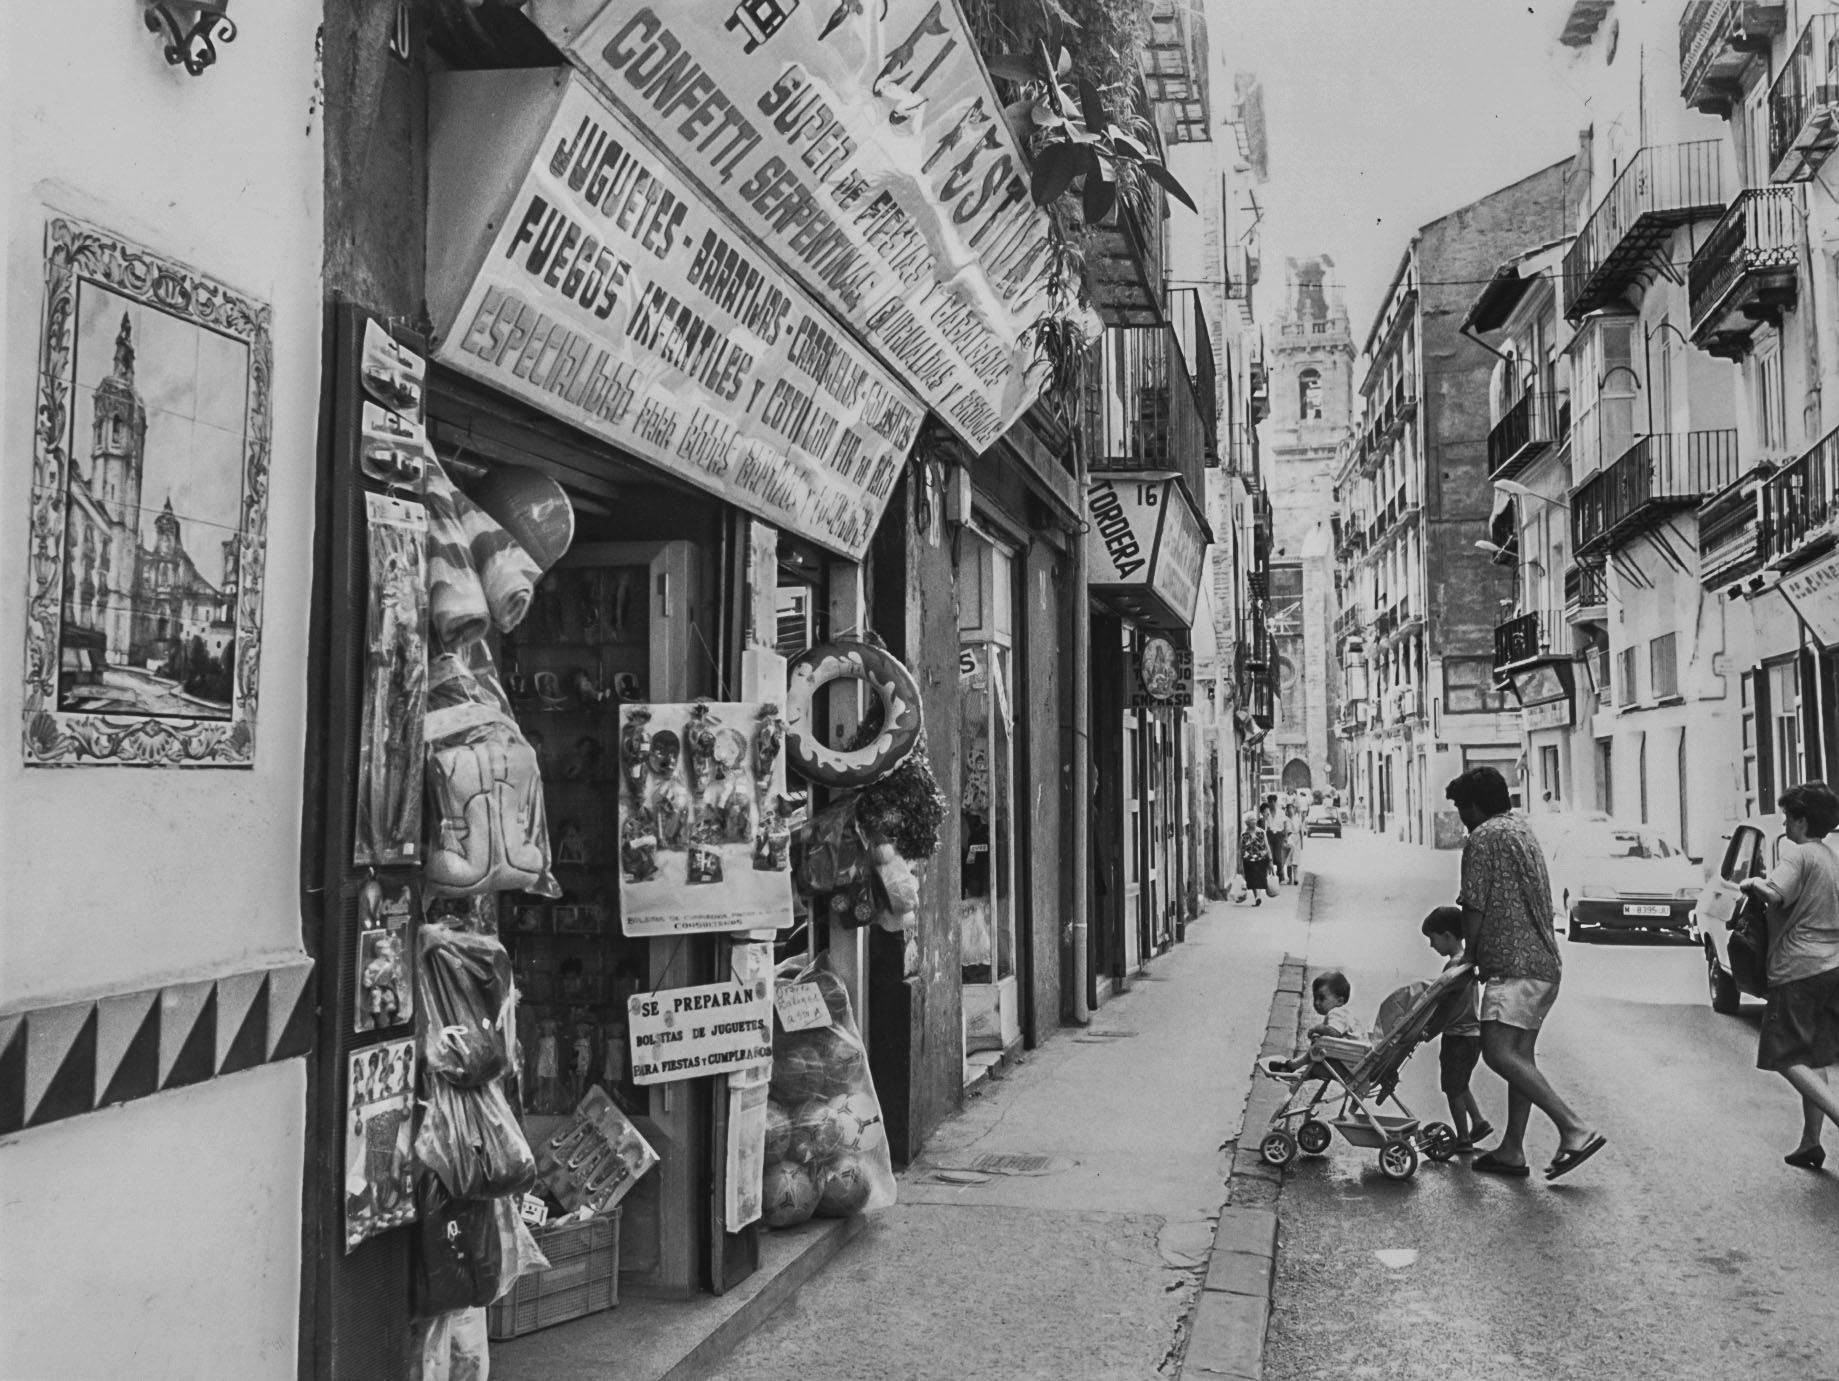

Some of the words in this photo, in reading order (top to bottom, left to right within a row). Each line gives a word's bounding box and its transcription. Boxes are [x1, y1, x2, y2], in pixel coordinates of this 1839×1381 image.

[602, 7, 762, 184] CONFETTI,
[866, 296, 957, 392] GUIRNALDAS
[757, 64, 857, 182] SUPER
[854, 190, 937, 288] FIESTAS
[549, 115, 687, 260] JUGUETES
[686, 230, 792, 346] BARATIJAS
[784, 313, 869, 412] CARAMELOS
[460, 285, 640, 426] ESPECIALIDAD
[630, 394, 682, 450] PARA
[675, 405, 744, 479] BODAS
[624, 280, 755, 406] INFANTILES
[829, 427, 864, 478] FIN
[1088, 481, 1146, 580] TORDERA
[1137, 484, 1158, 506] 16
[633, 1063, 659, 1077] PARA
[661, 1058, 700, 1073] FIESTAS
[636, 1030, 683, 1047] BOLITAS
[692, 1027, 706, 1040] DE
[711, 1018, 764, 1036] JUGUETES
[641, 1000, 660, 1018] SE
[674, 988, 753, 1014] PREPARAN
